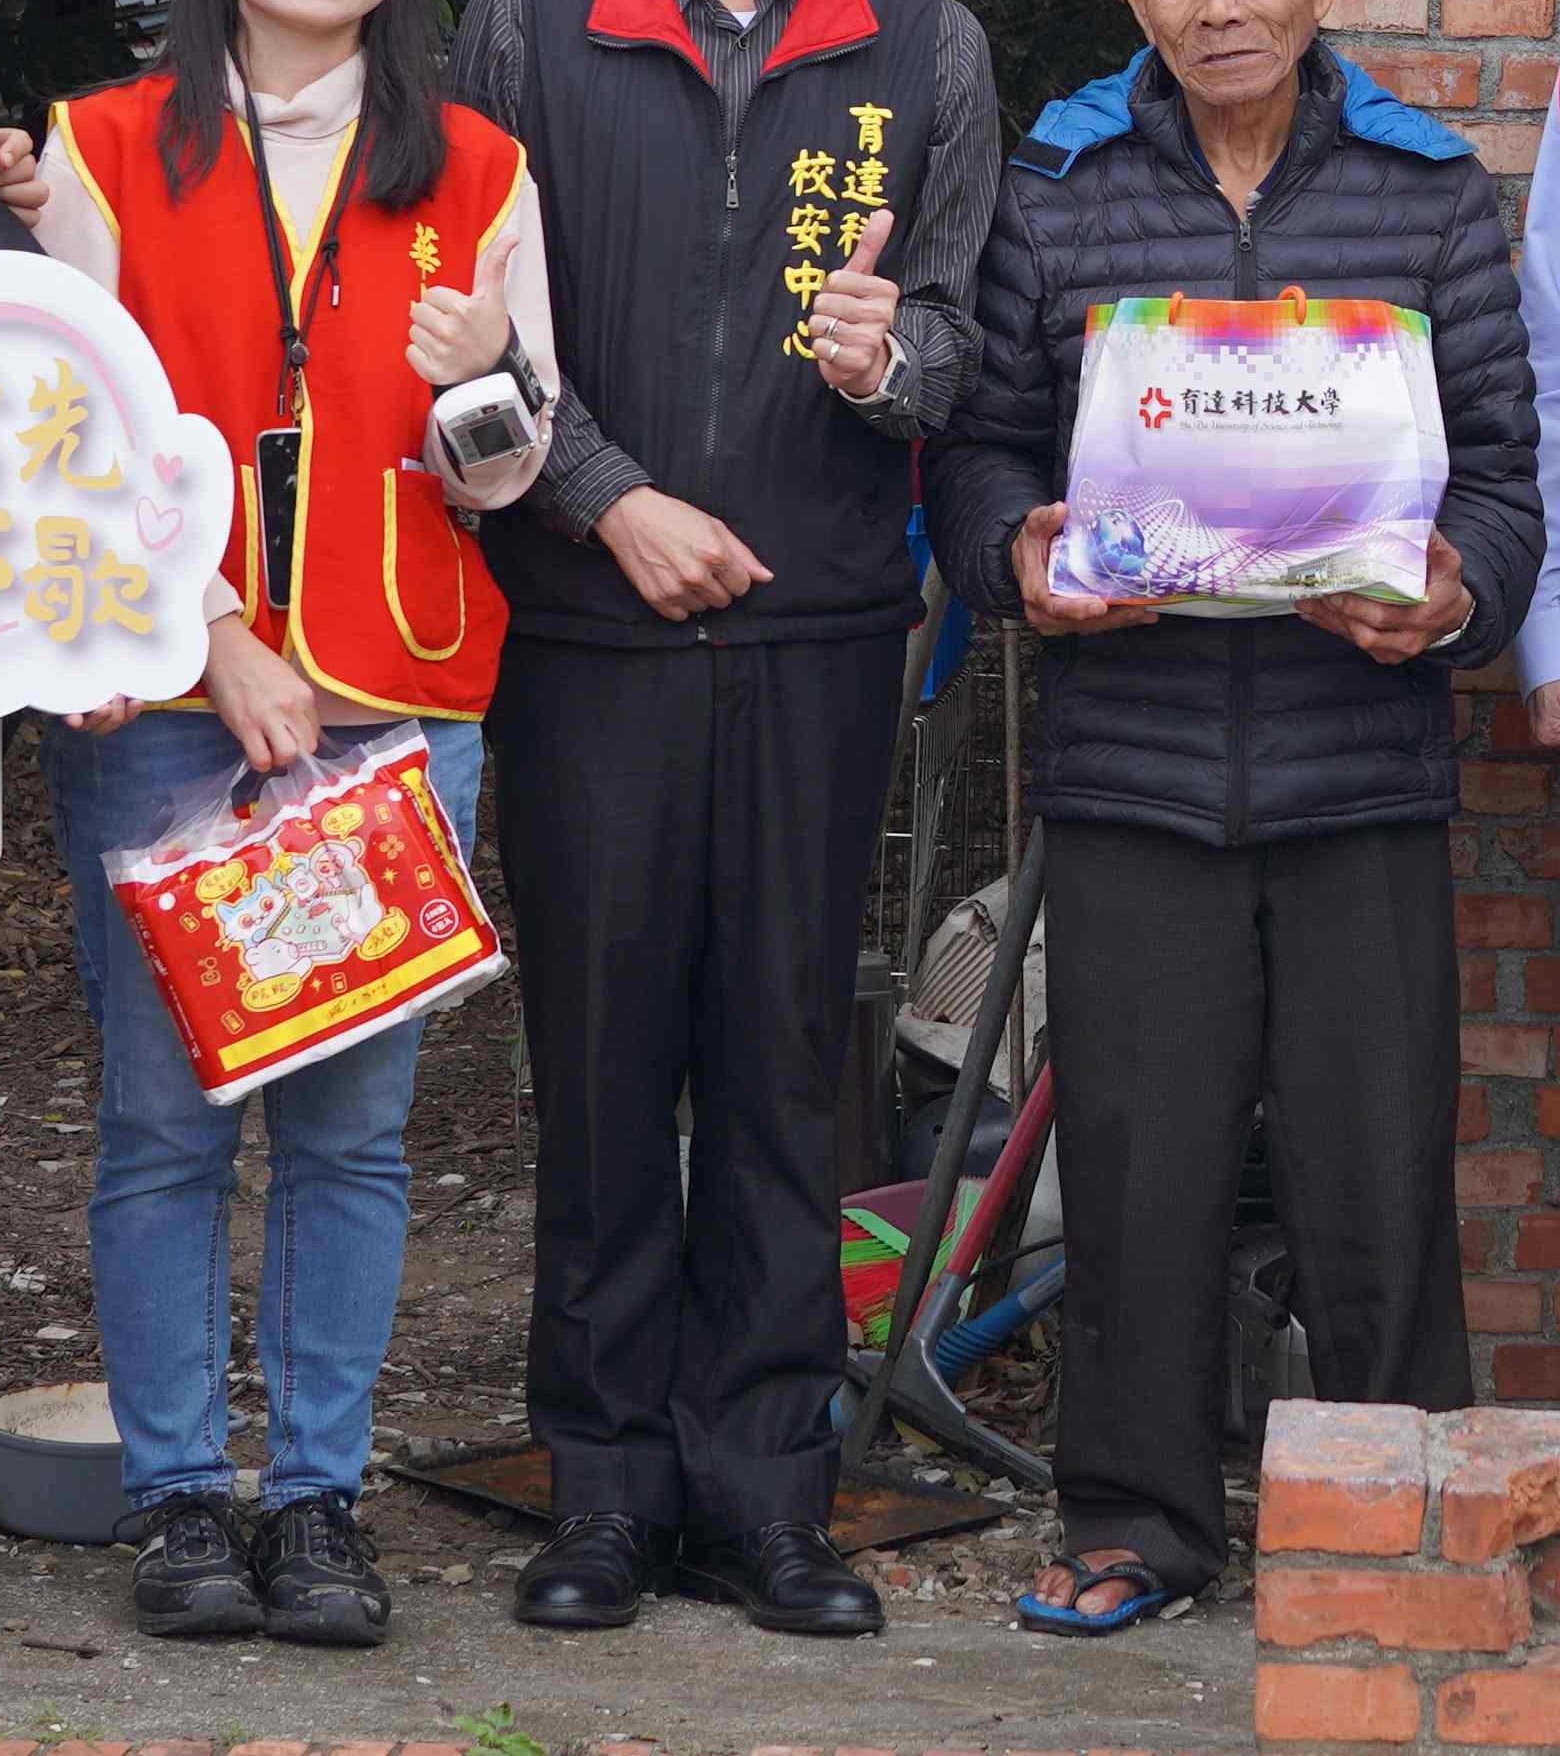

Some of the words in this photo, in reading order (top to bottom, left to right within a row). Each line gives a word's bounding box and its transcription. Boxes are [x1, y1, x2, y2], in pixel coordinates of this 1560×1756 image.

[783, 148, 838, 360] 校安中心
[1180, 386, 1342, 416] 育達科技大學
